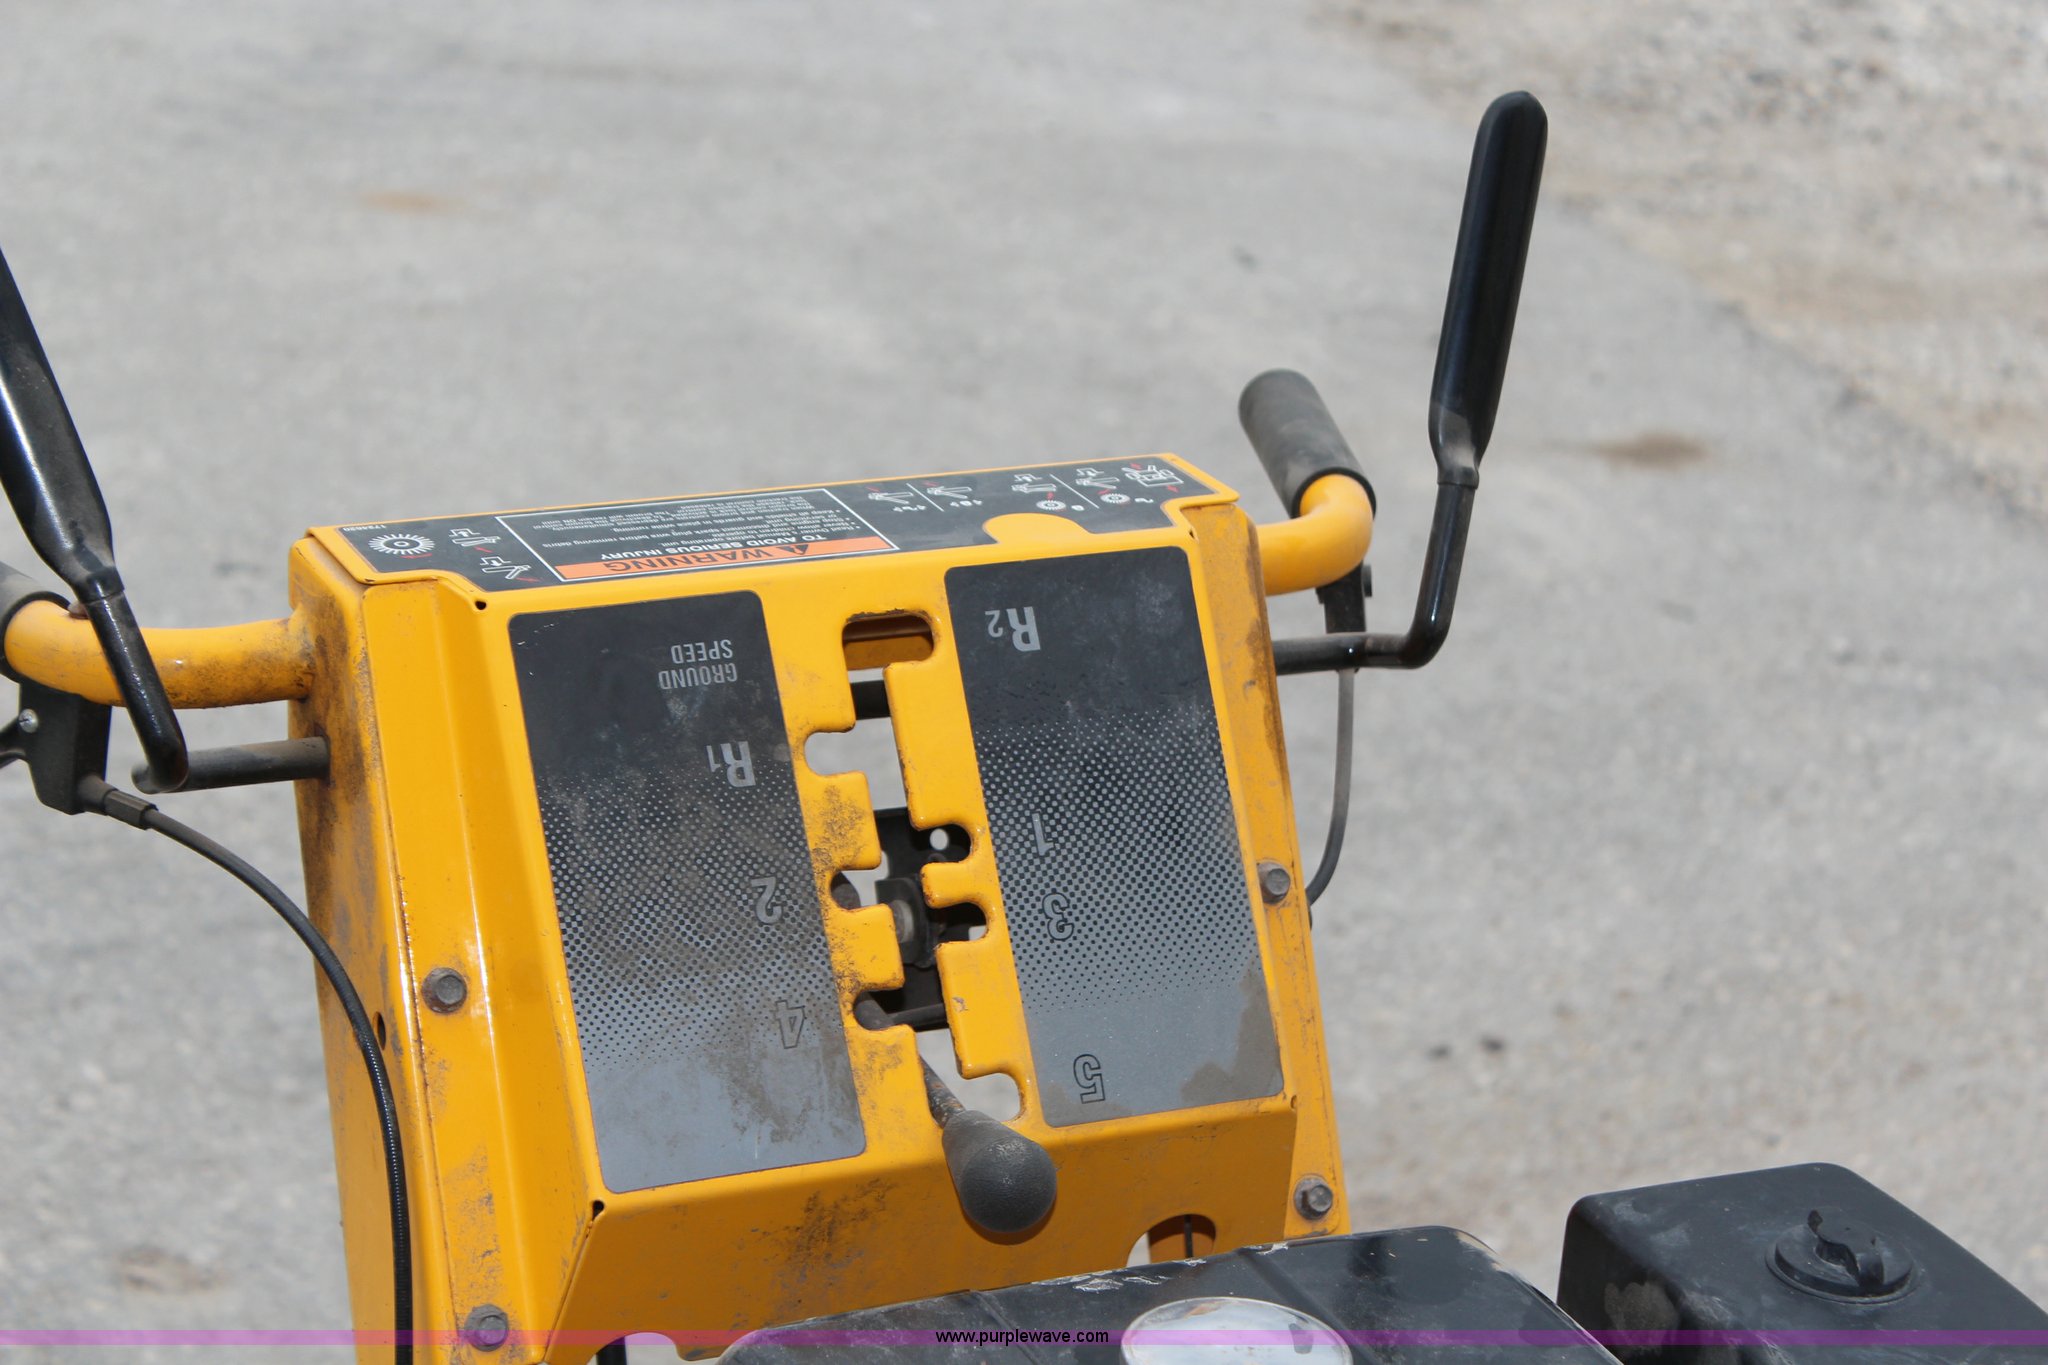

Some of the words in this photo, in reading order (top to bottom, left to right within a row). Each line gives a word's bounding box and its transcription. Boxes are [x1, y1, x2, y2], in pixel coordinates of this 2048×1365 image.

[599, 549, 663, 559] INJURY
[663, 541, 744, 553] SERIOUS
[743, 536, 799, 546] AVOID
[603, 548, 771, 571] WARNING
[671, 638, 734, 664] SPEED
[658, 661, 738, 690] GROUND
[1031, 812, 1055, 857] 1
[750, 876, 782, 924] 2
[1042, 892, 1075, 941] 3
[775, 1000, 806, 1049] 4
[1073, 1053, 1105, 1104] 5
